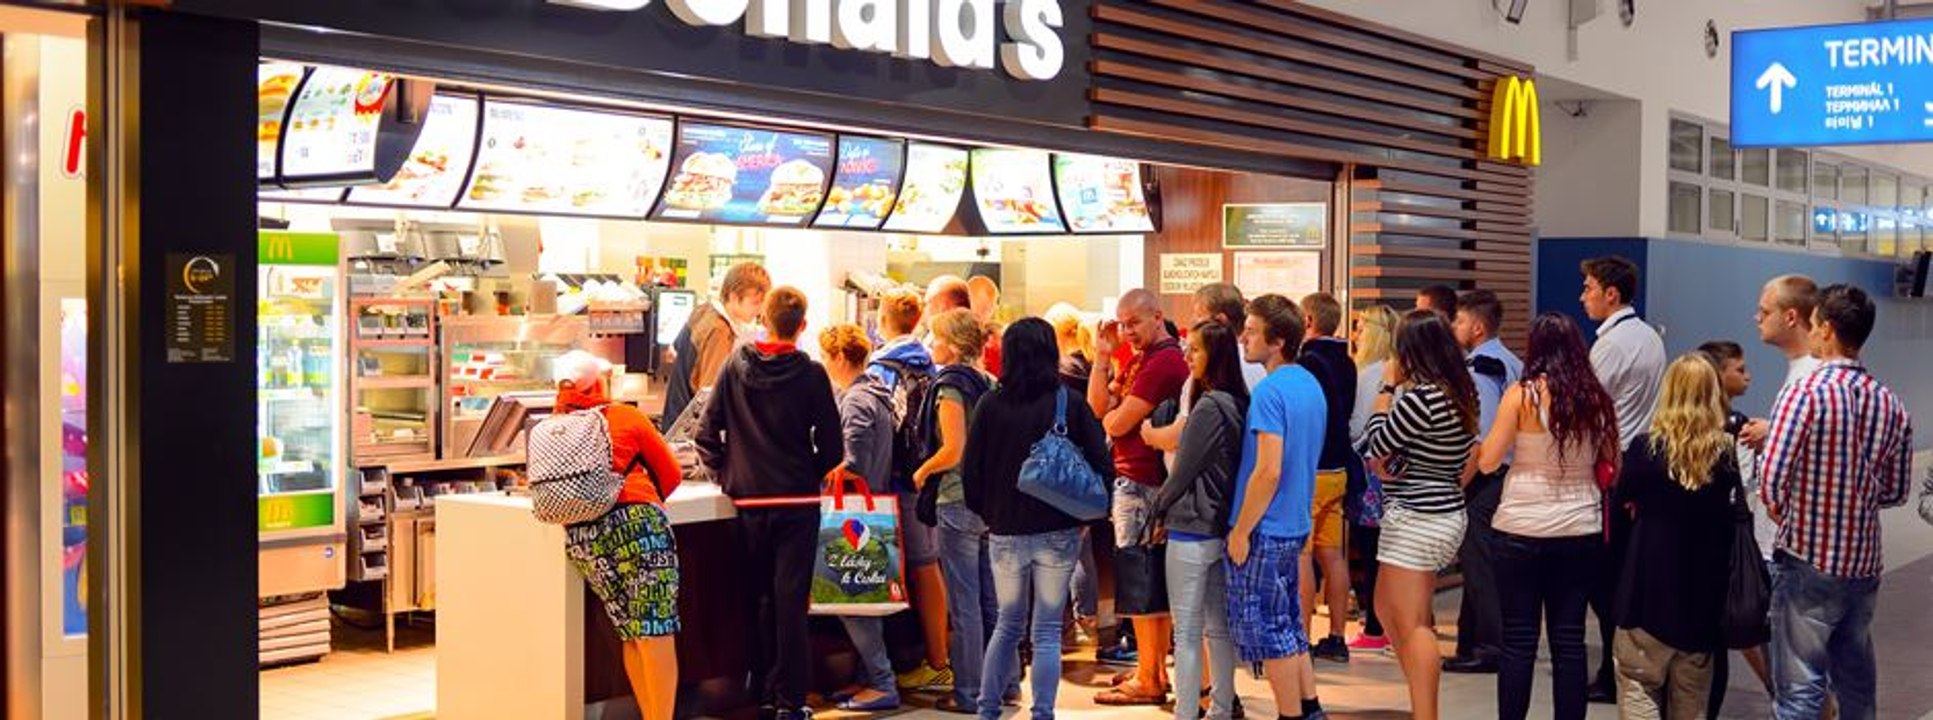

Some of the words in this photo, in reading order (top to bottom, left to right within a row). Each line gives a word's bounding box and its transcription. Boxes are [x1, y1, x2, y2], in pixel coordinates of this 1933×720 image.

[1825, 82, 1884, 98] TERMINÁL
[1887, 82, 1894, 96] 1
[1893, 98, 1899, 112] 1
[1867, 115, 1874, 128] 1
